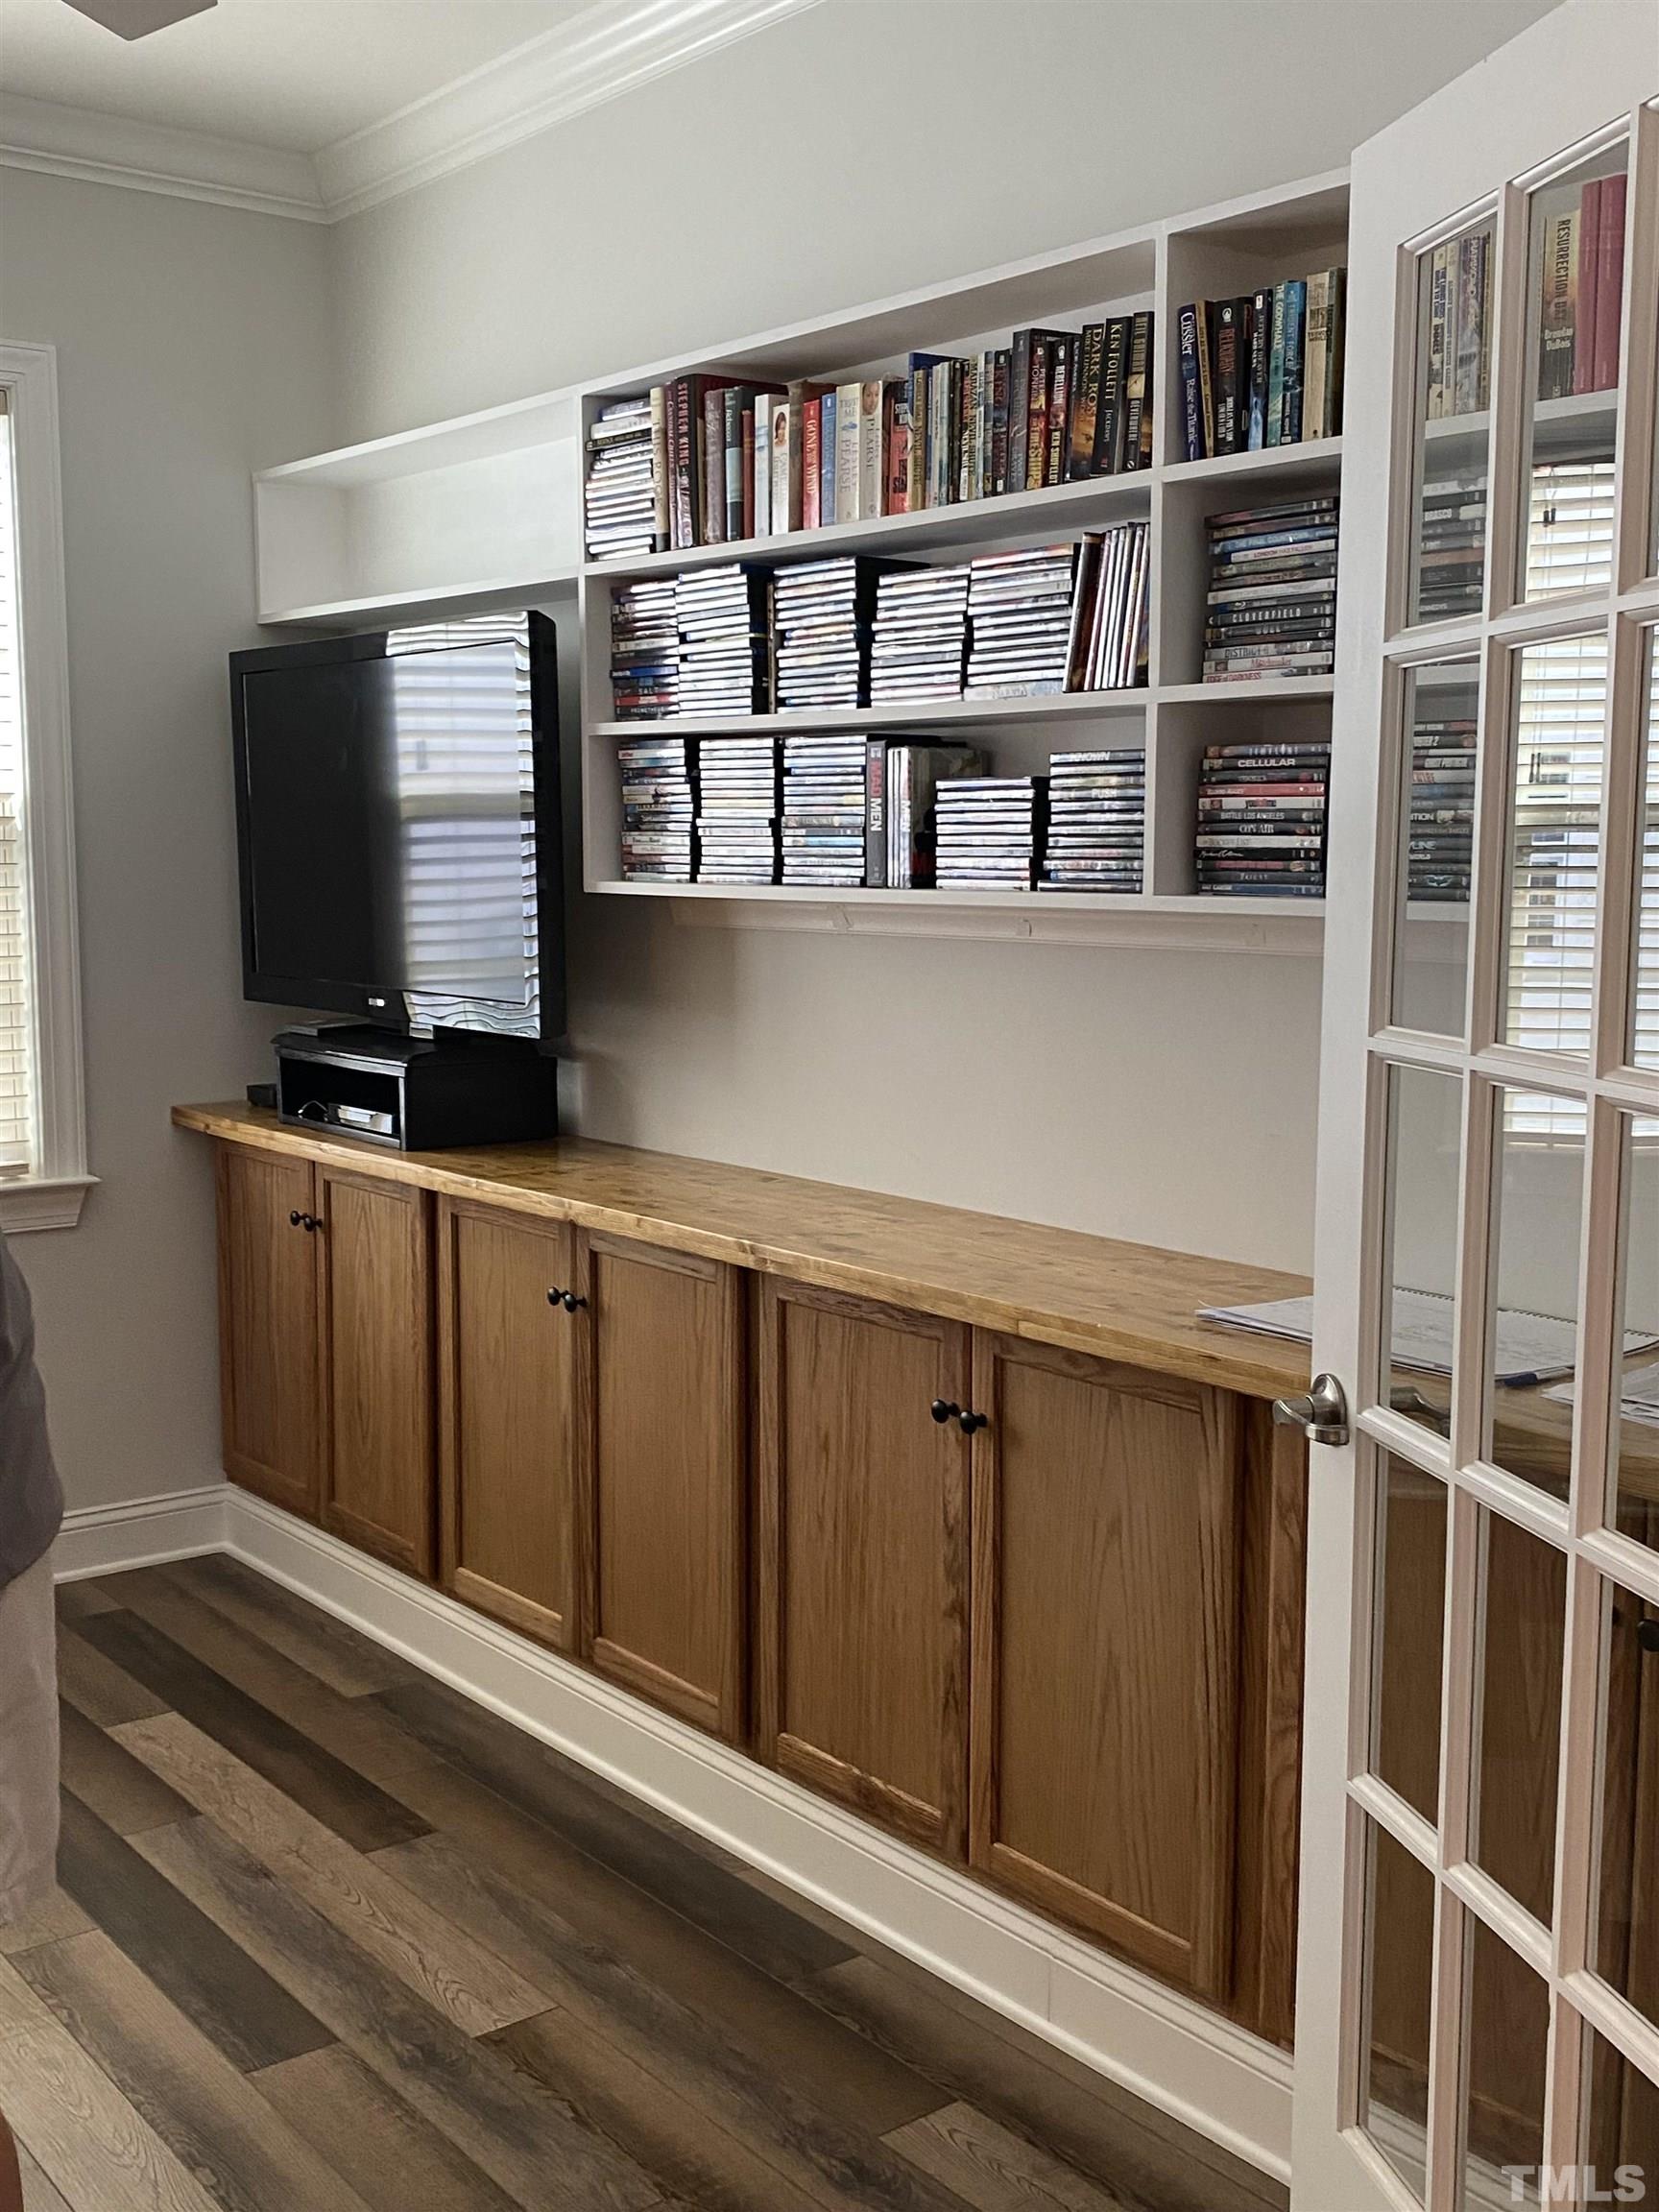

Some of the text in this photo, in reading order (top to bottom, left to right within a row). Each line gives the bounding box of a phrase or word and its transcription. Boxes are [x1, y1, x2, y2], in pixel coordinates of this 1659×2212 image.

[1554, 219, 1572, 299] RESURRECTION
[1084, 329, 1093, 351] MIKE
[1180, 312, 1196, 355] Cussler
[1105, 324, 1122, 400] KEN FOLLETT
[1285, 341, 1294, 368] FORCE
[969, 363, 977, 410] MARAZAN
[1053, 365, 1066, 405] REBELLION
[1086, 328, 1102, 425] DARK ROSE
[1186, 378, 1196, 402] Raise
[677, 383, 689, 433] STEPHEN
[1127, 399, 1141, 442] NEVERWHERE
[806, 420, 817, 451] GONE
[1188, 415, 1198, 443] Titanic
[679, 437, 689, 466] KING
[866, 418, 875, 471] PEARSE
[806, 465, 816, 494] WIND
[839, 440, 852, 493] PEARSE
[1233, 608, 1301, 622] CLOVERFIELD
[1225, 648, 1261, 658] DISTRICT
[1227, 672, 1262, 682] DARKNESS
[1238, 758, 1296, 768] CELLULAR
[870, 760, 883, 831] MAD MEN
[1092, 788, 1118, 799] PUSH
[1221, 811, 1242, 820] BATTLE
[1239, 824, 1274, 833] CON AIR
